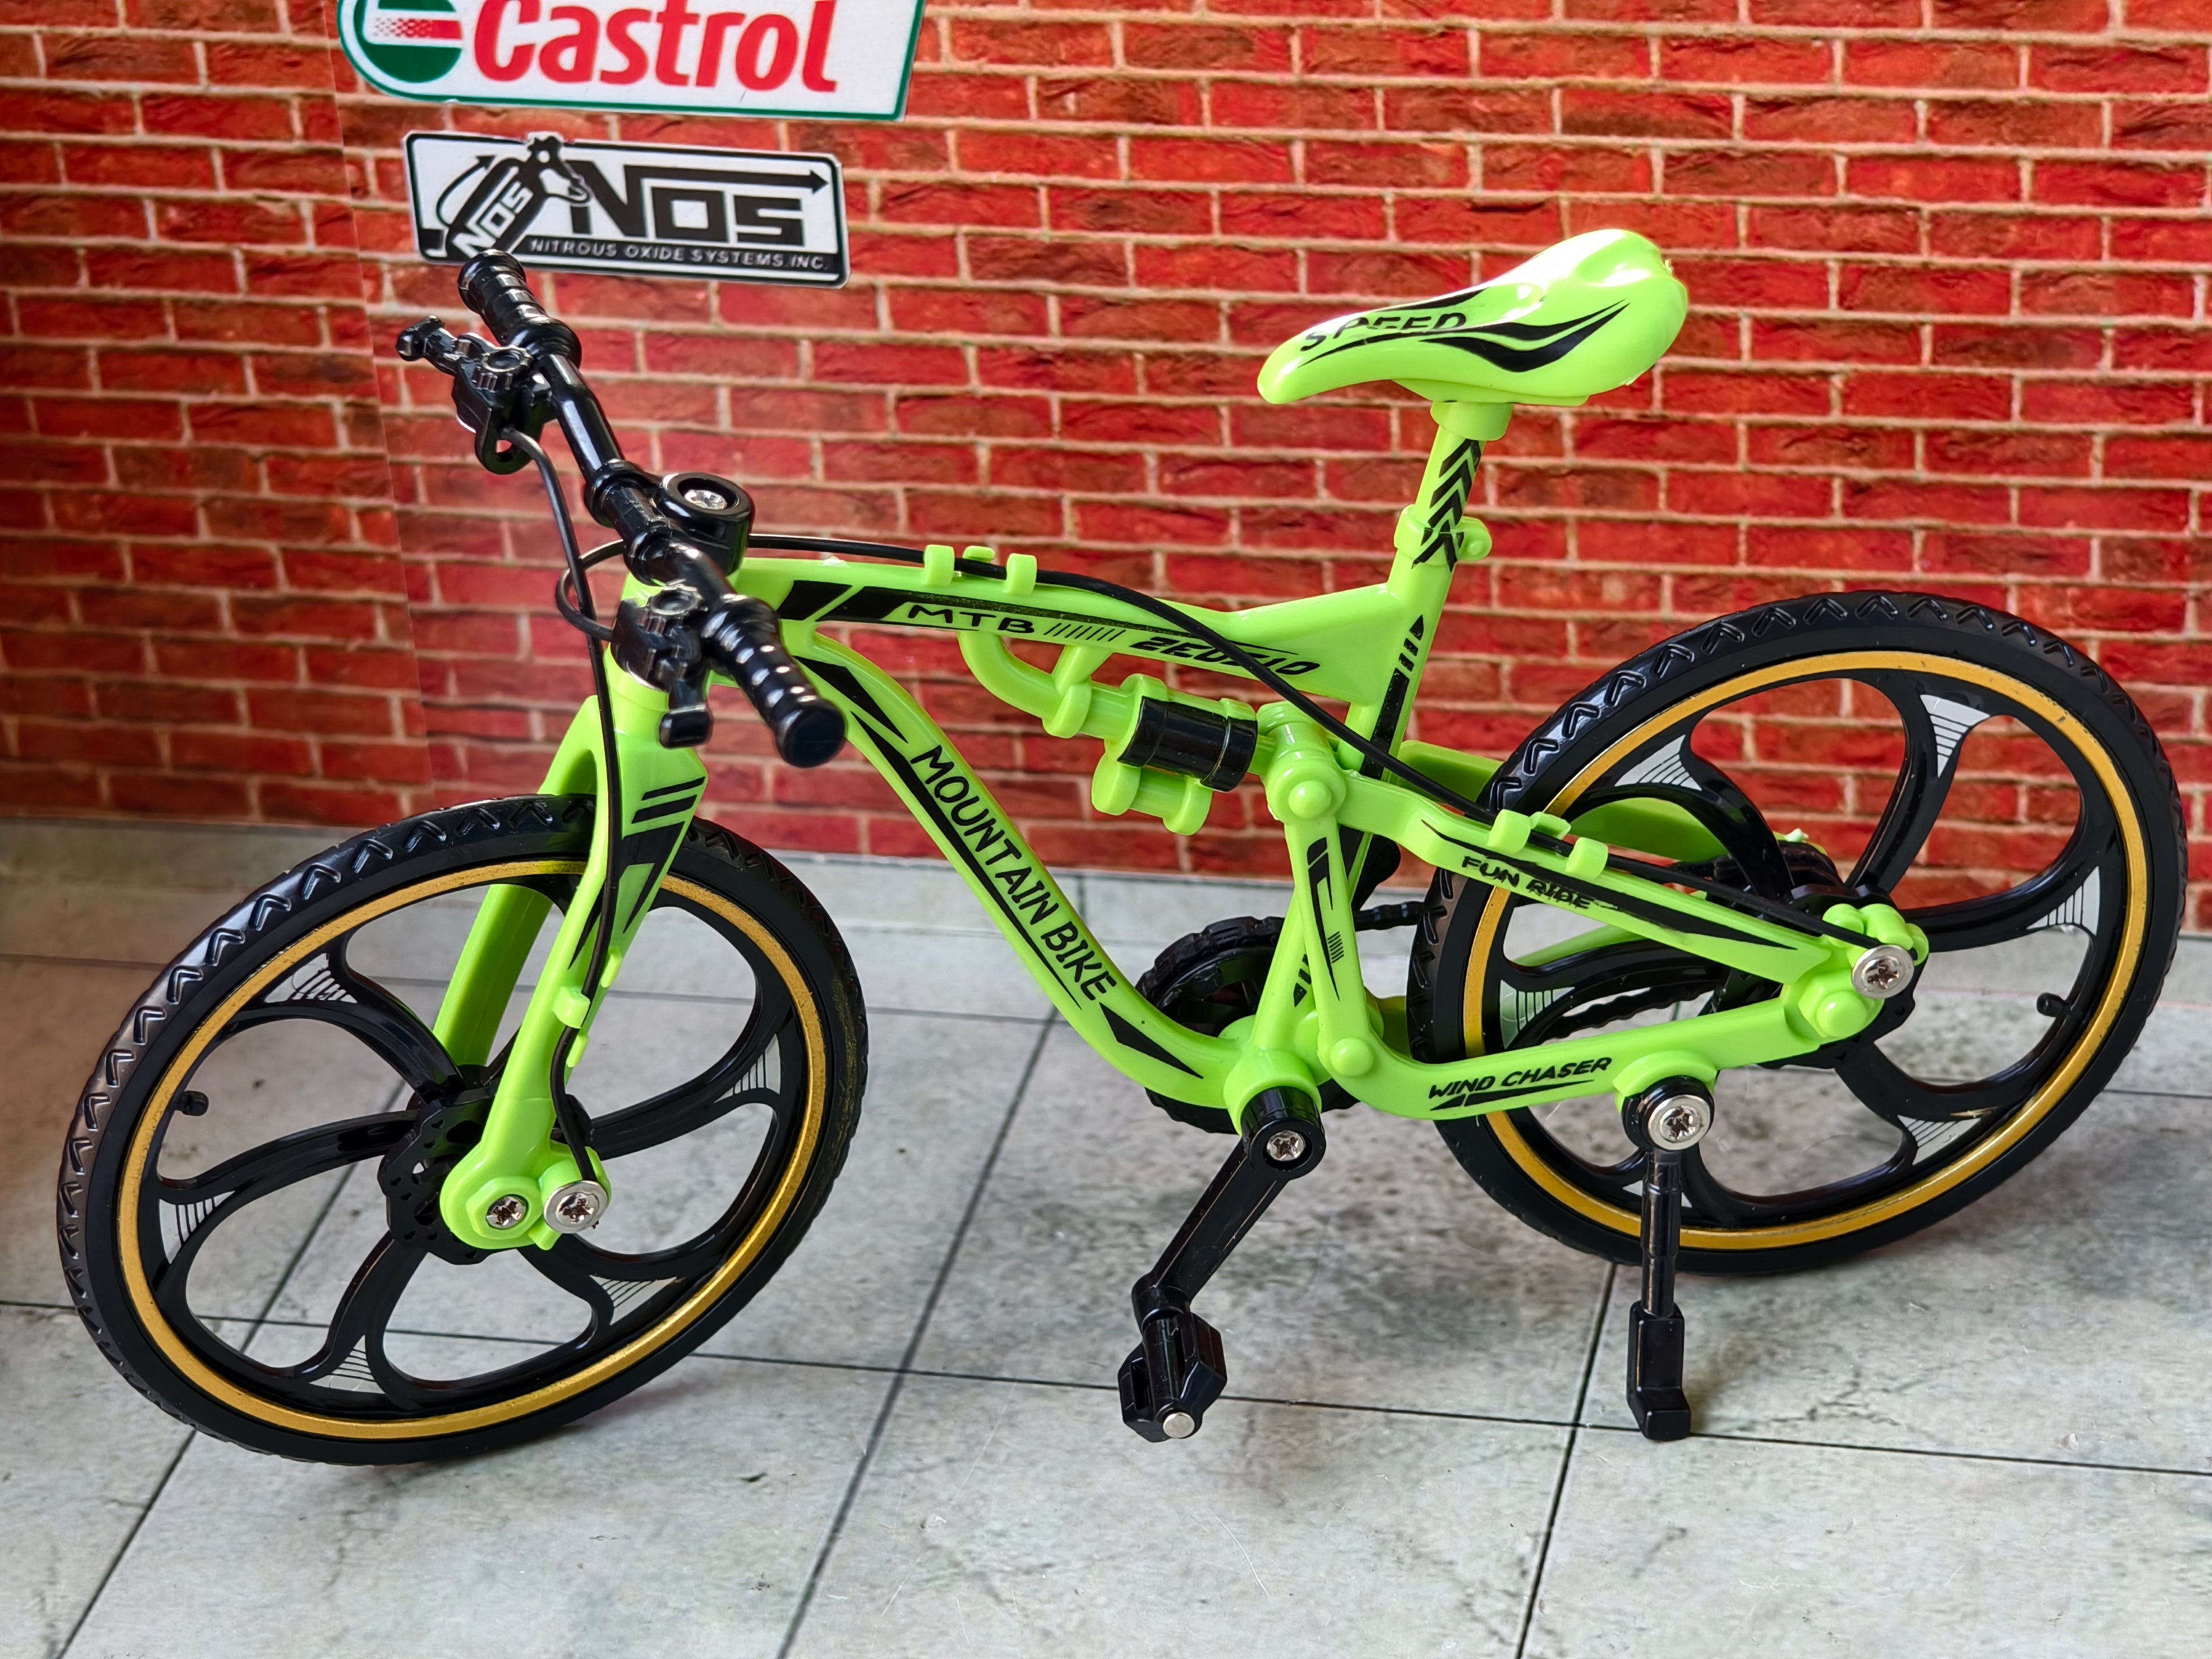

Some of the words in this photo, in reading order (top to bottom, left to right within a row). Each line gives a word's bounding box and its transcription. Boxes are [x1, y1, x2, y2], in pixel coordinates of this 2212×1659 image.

[474, 0, 837, 93] Castrol
[452, 166, 533, 258] NOS
[565, 160, 805, 246] NOS
[529, 238, 617, 257] NITROUS
[624, 245, 685, 262] OXIDE
[1300, 312, 1467, 352] SPEED
[907, 604, 1036, 634] MTB
[910, 744, 1060, 926] MOUNTAIN
[1040, 921, 1118, 1001] BIKE
[1461, 856, 1520, 888] FUN
[1525, 878, 1592, 910] RIDE
[1429, 1075, 1497, 1099] WIND
[1501, 1056, 1612, 1086] CHASER
